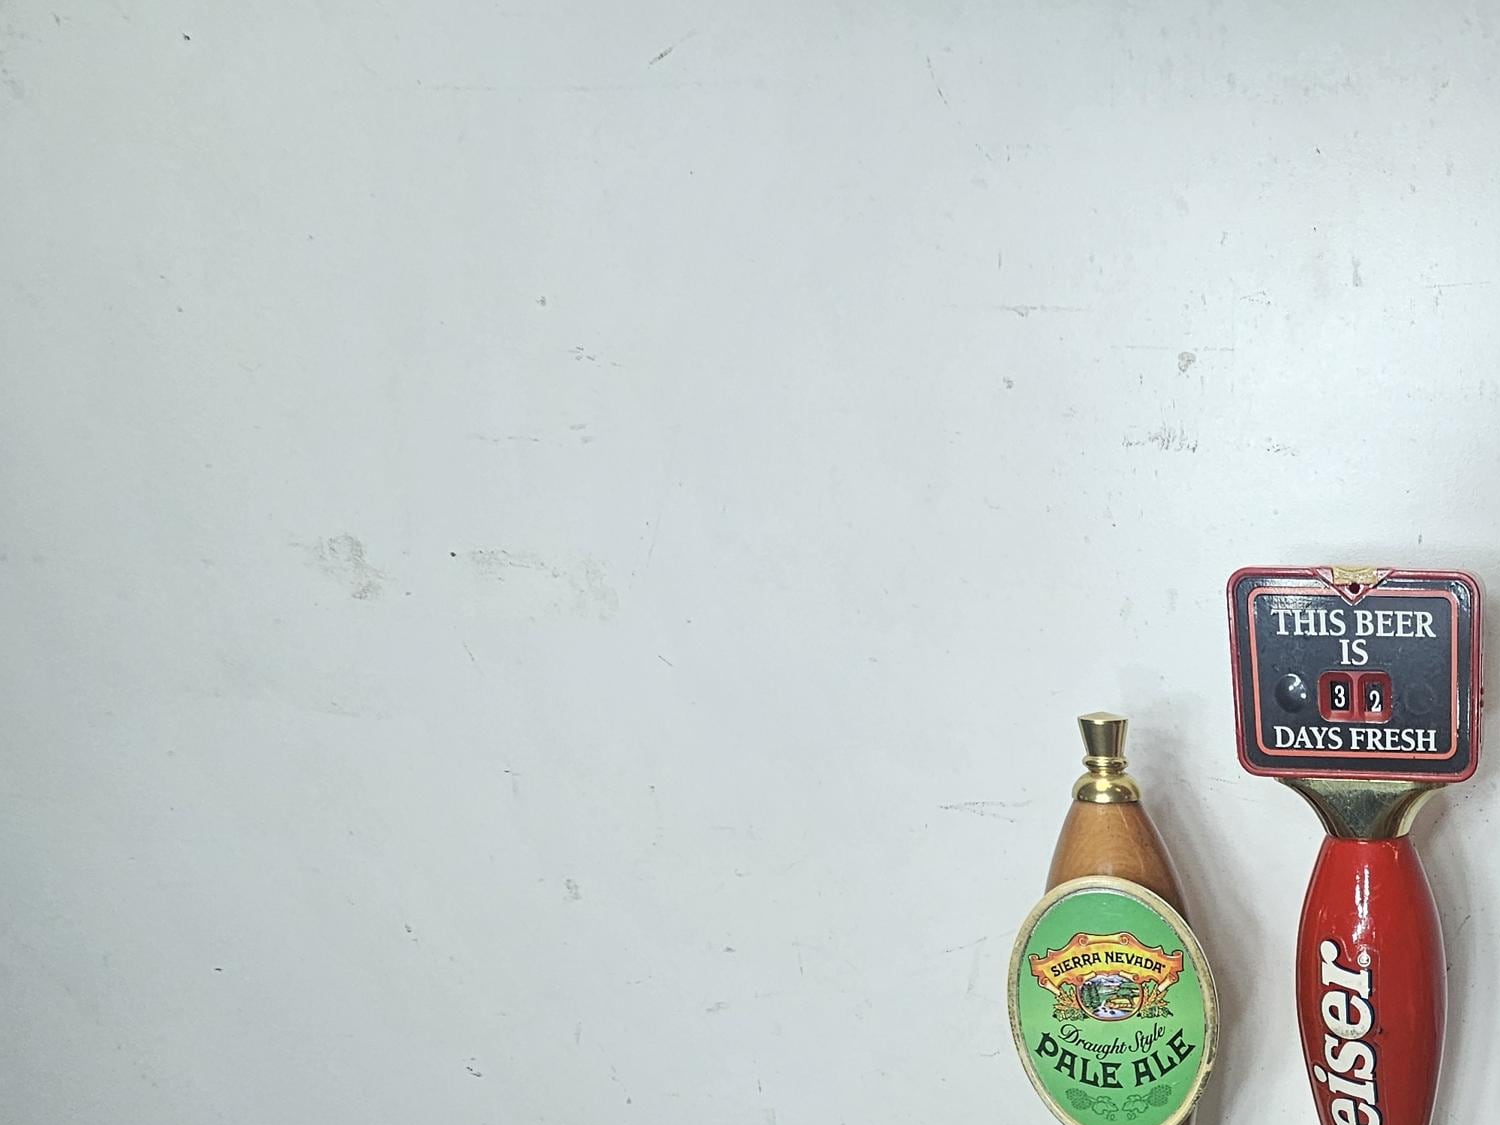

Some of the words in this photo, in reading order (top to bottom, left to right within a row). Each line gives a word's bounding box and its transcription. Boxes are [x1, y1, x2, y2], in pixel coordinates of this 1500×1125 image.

[1271, 609, 1346, 636] THIS
[1355, 610, 1436, 637] BEER
[1339, 639, 1368, 665] IS
[1273, 726, 1343, 750] DAYS
[1349, 728, 1437, 752] FRESH
[1051, 952, 1103, 977] SIERRA
[1104, 951, 1163, 974] NEVADA
[1058, 1023, 1127, 1060] Draught
[1128, 1022, 1166, 1053] Style
[1035, 1032, 1124, 1089] PALE
[1131, 1028, 1196, 1087] ALE
